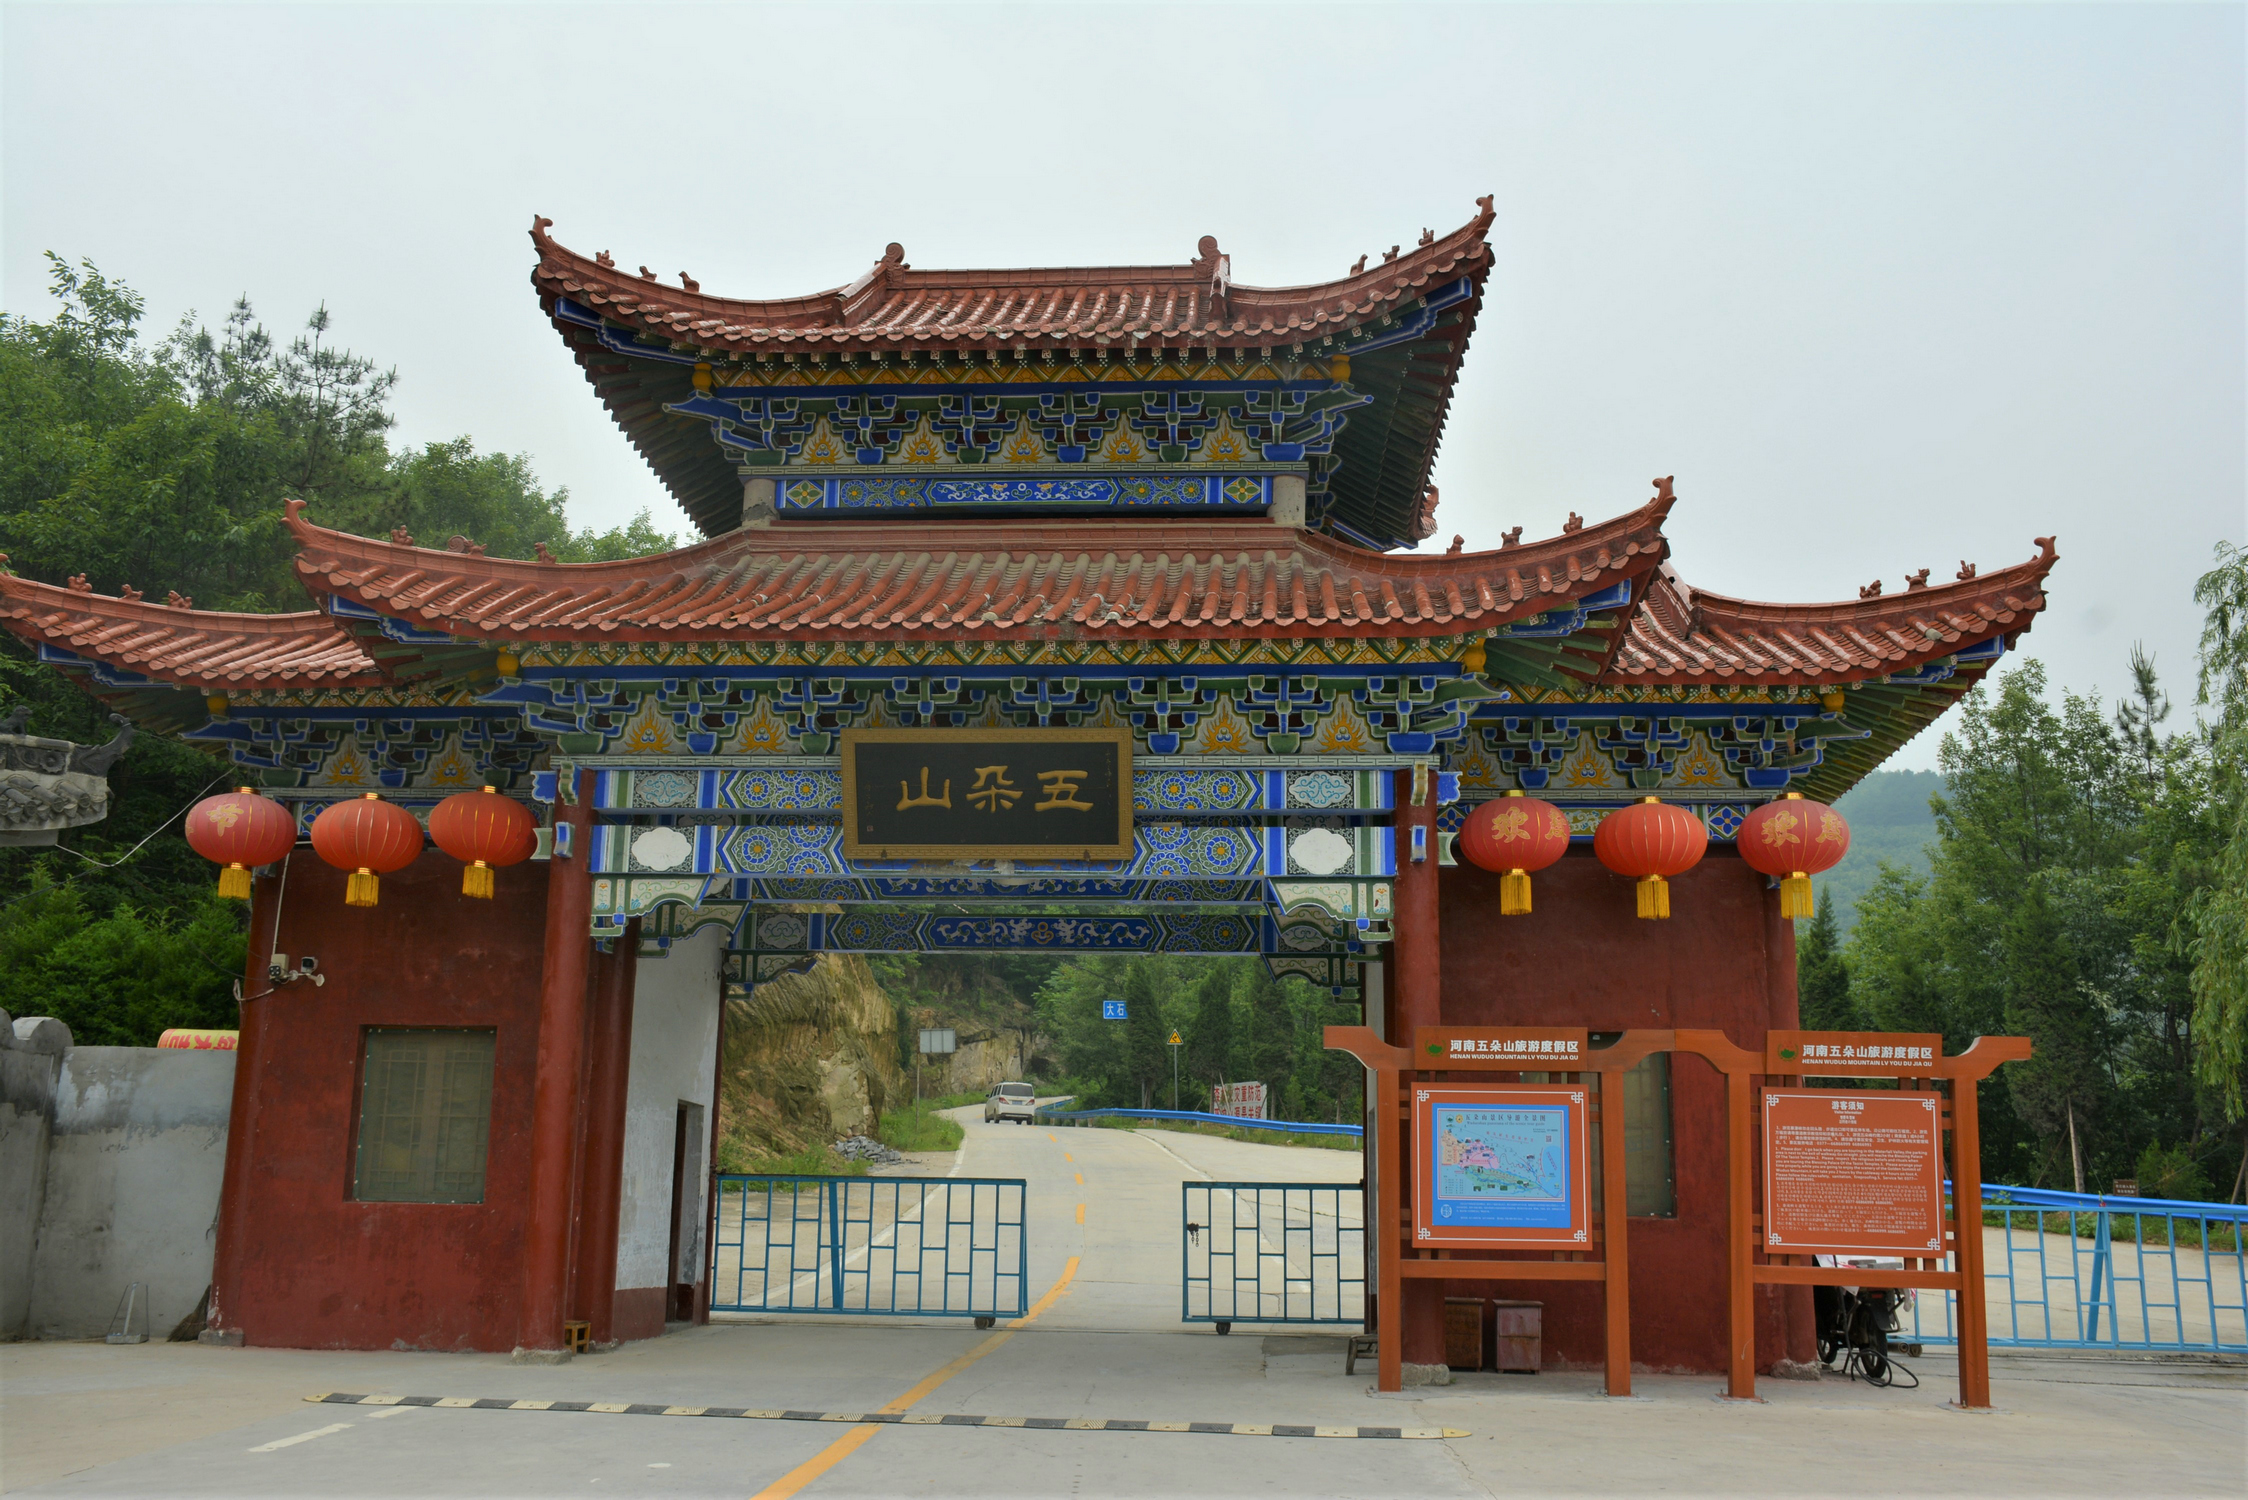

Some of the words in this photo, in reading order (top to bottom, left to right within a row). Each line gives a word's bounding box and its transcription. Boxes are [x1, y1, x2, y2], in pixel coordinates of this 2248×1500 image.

[1450, 1040, 1578, 1052] 河南五朵山旅游度假区
[1802, 1045, 1932, 1059] 河南五朵山旅游度假区
[1832, 1100, 1864, 1110] 游客须知
